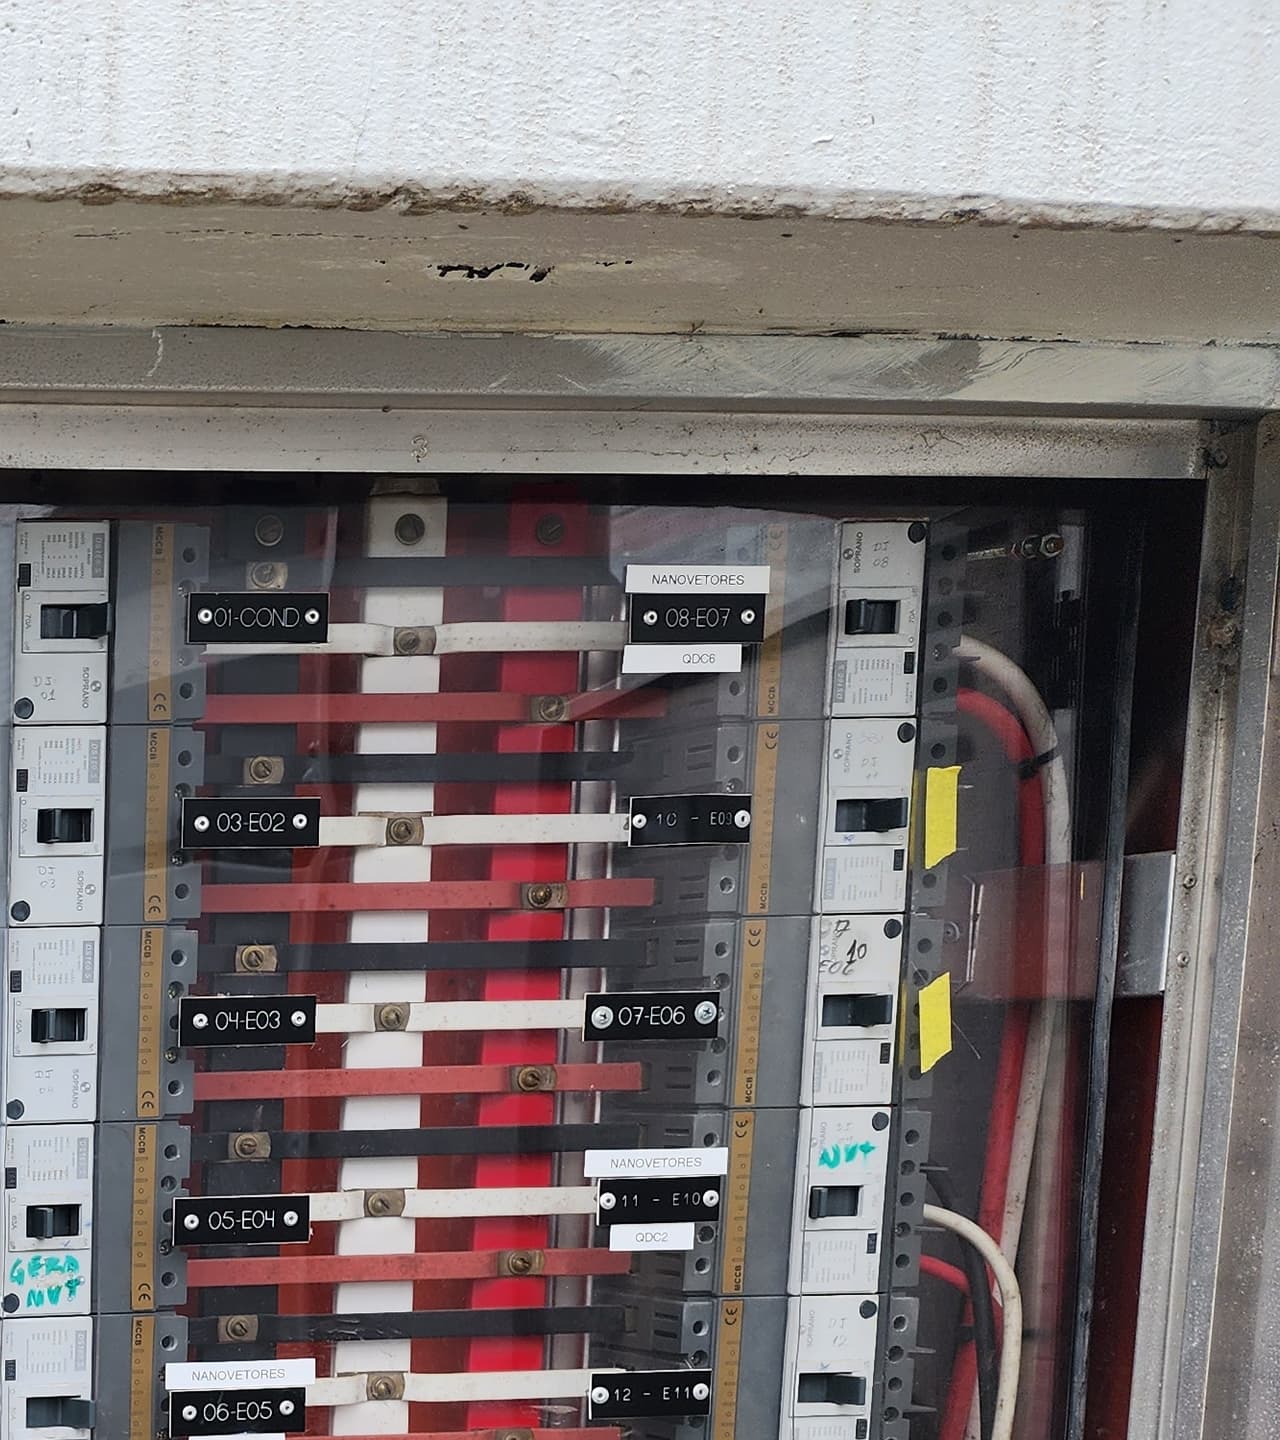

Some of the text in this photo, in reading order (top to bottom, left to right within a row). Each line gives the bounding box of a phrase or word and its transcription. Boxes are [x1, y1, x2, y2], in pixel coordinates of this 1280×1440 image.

[853, 531, 864, 573] SOPRANO
[651, 574, 745, 586] NANOVETORES
[213, 608, 300, 627] 01-COND
[665, 607, 730, 627] 08-E07
[682, 653, 716, 665] QDC6
[81, 667, 90, 709] SOPRANO
[216, 814, 285, 833] 03-E02
[710, 811, 733, 826] E09
[75, 870, 85, 912] SOPRANO
[215, 1012, 280, 1030] 04-E03
[618, 1006, 686, 1025] 07-E06
[610, 1157, 702, 1169] NANOVETORES
[621, 1195, 638, 1207] 11
[672, 1192, 701, 1206] E10
[208, 1211, 277, 1230] 05-E04
[635, 1232, 669, 1244] QDC2
[191, 1368, 286, 1382] NANOVETORES
[613, 1388, 631, 1401] 12
[662, 1386, 690, 1400] E11
[203, 1403, 272, 1421] 06-E05
